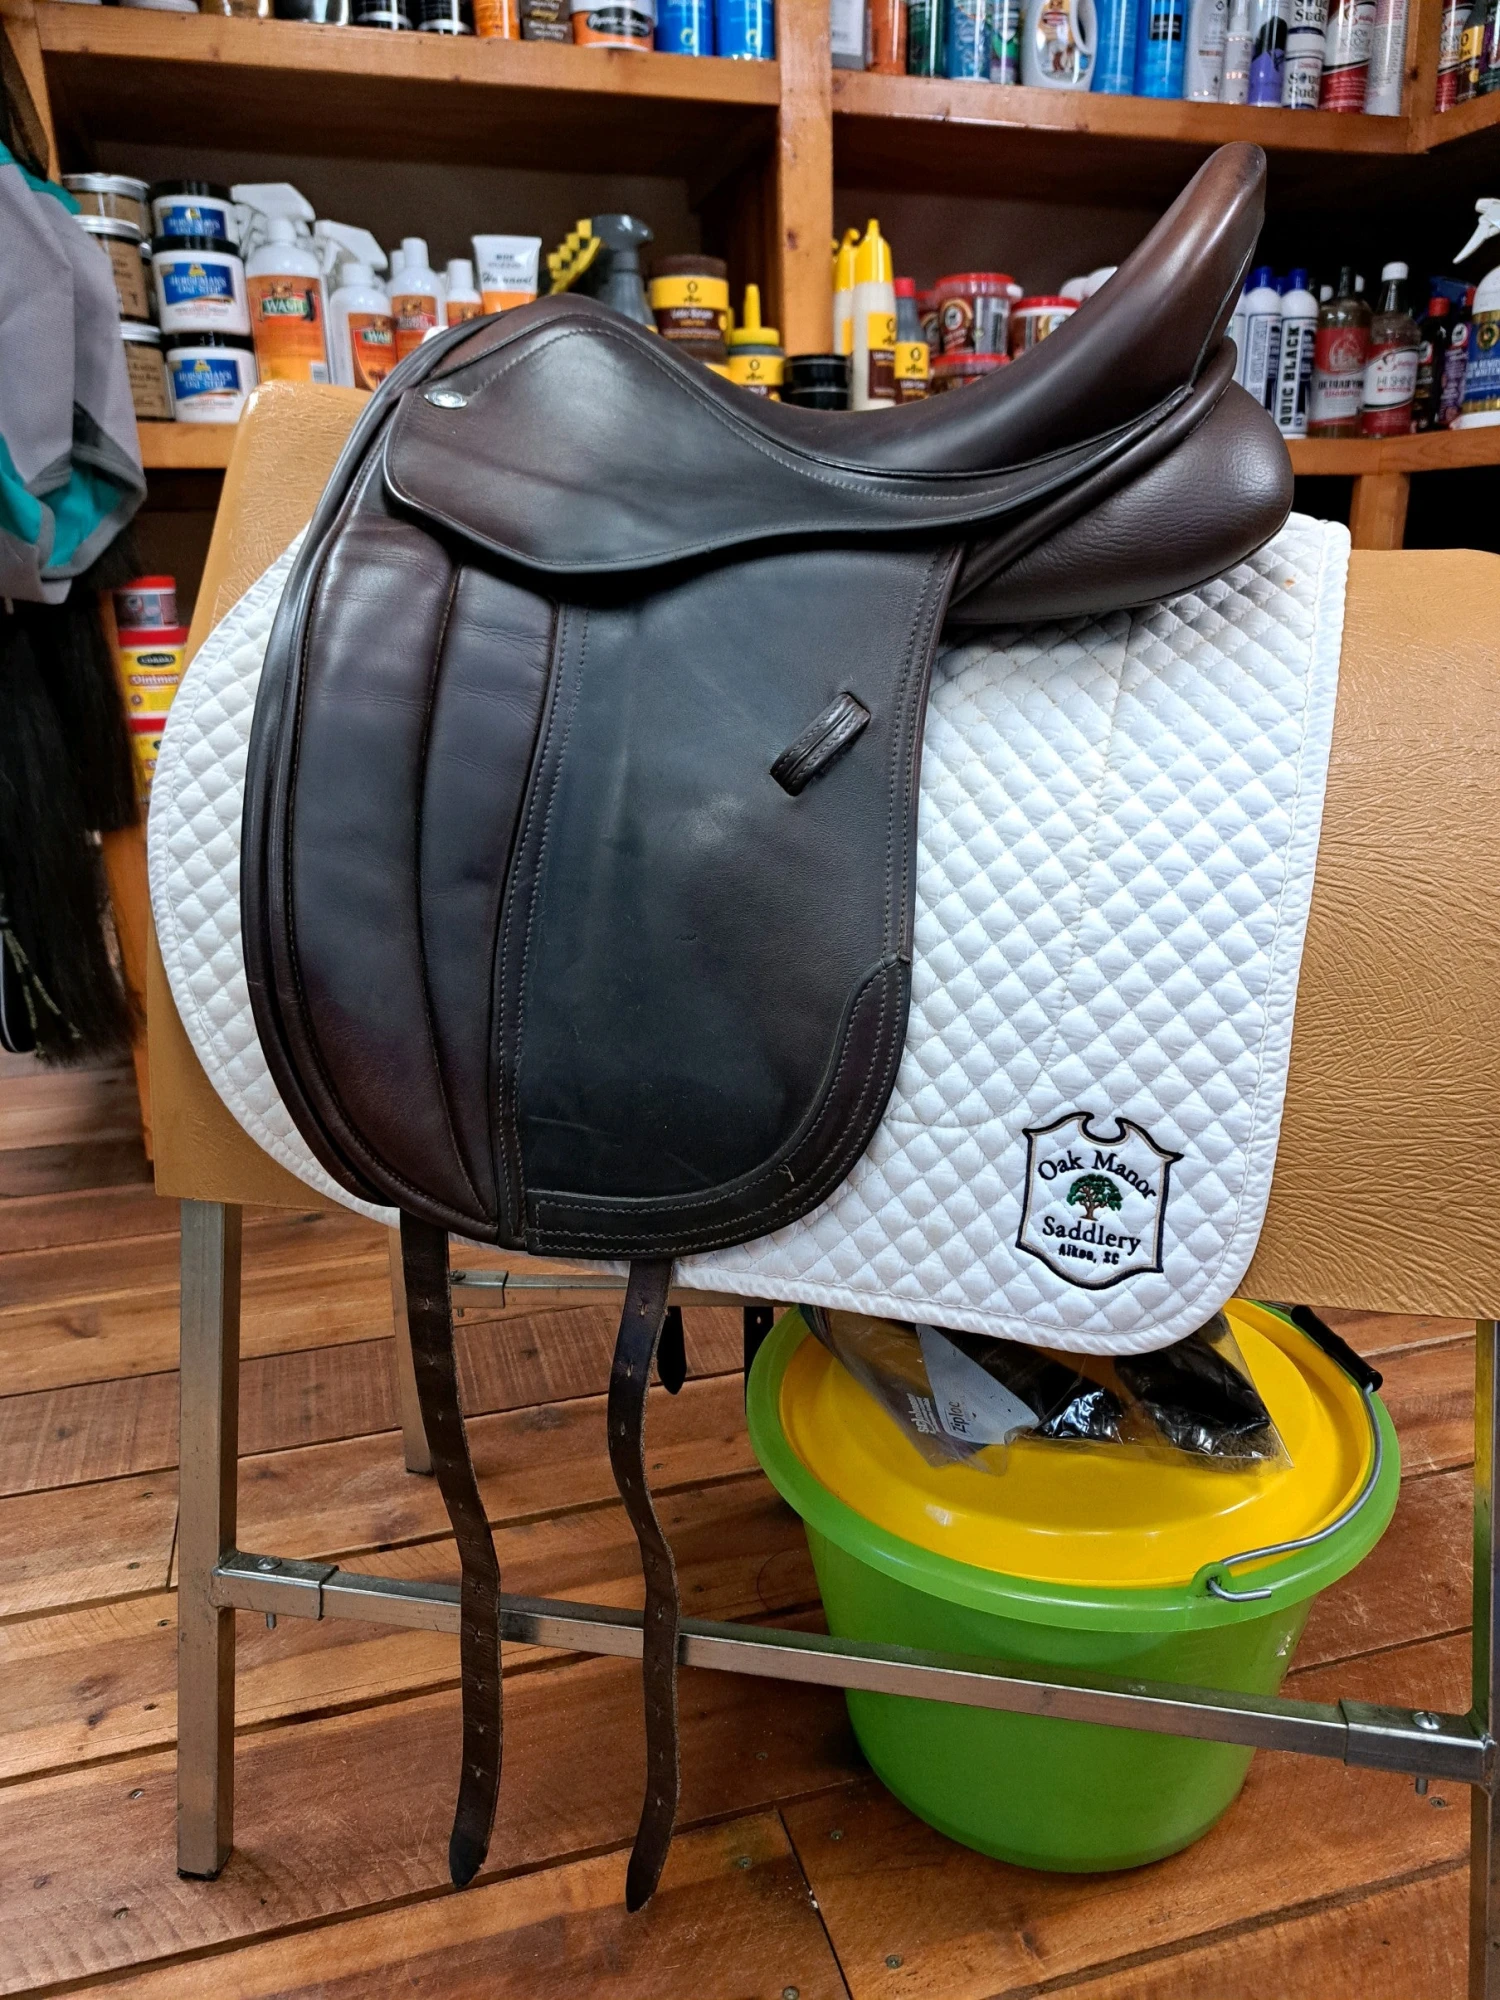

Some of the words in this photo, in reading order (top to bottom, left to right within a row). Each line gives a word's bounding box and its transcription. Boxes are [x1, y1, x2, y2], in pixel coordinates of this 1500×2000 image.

[266, 299, 304, 313] WASH
[1283, 326, 1300, 381] BLACK
[1279, 387, 1293, 426] QUIC
[1038, 1150, 1084, 1180] Oak
[1091, 1150, 1157, 1199] Manor
[1042, 1216, 1142, 1256] Saddlery
[1103, 1251, 1120, 1265] SC
